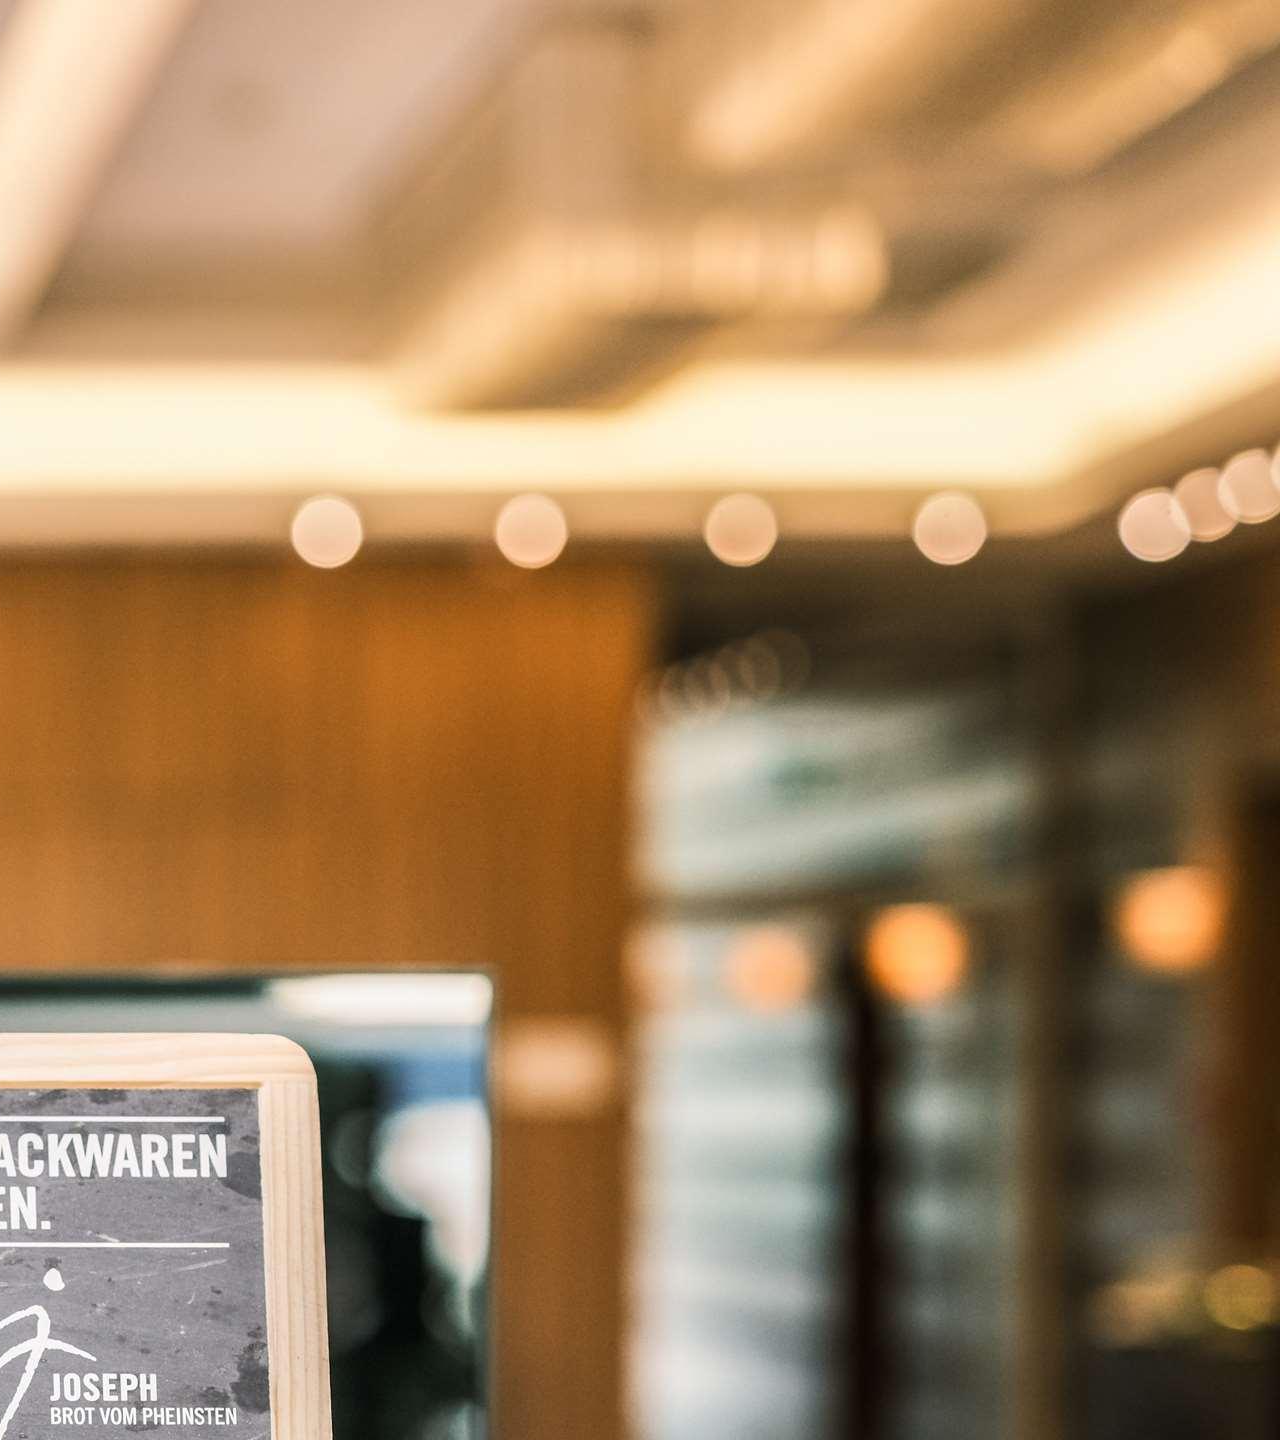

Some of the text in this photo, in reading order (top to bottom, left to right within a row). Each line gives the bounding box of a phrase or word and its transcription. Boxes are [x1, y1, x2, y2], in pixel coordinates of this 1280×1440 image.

[49, 1372, 158, 1402] JOSEPH
[50, 1406, 238, 1426] BROT VOM PHEINSTEN
